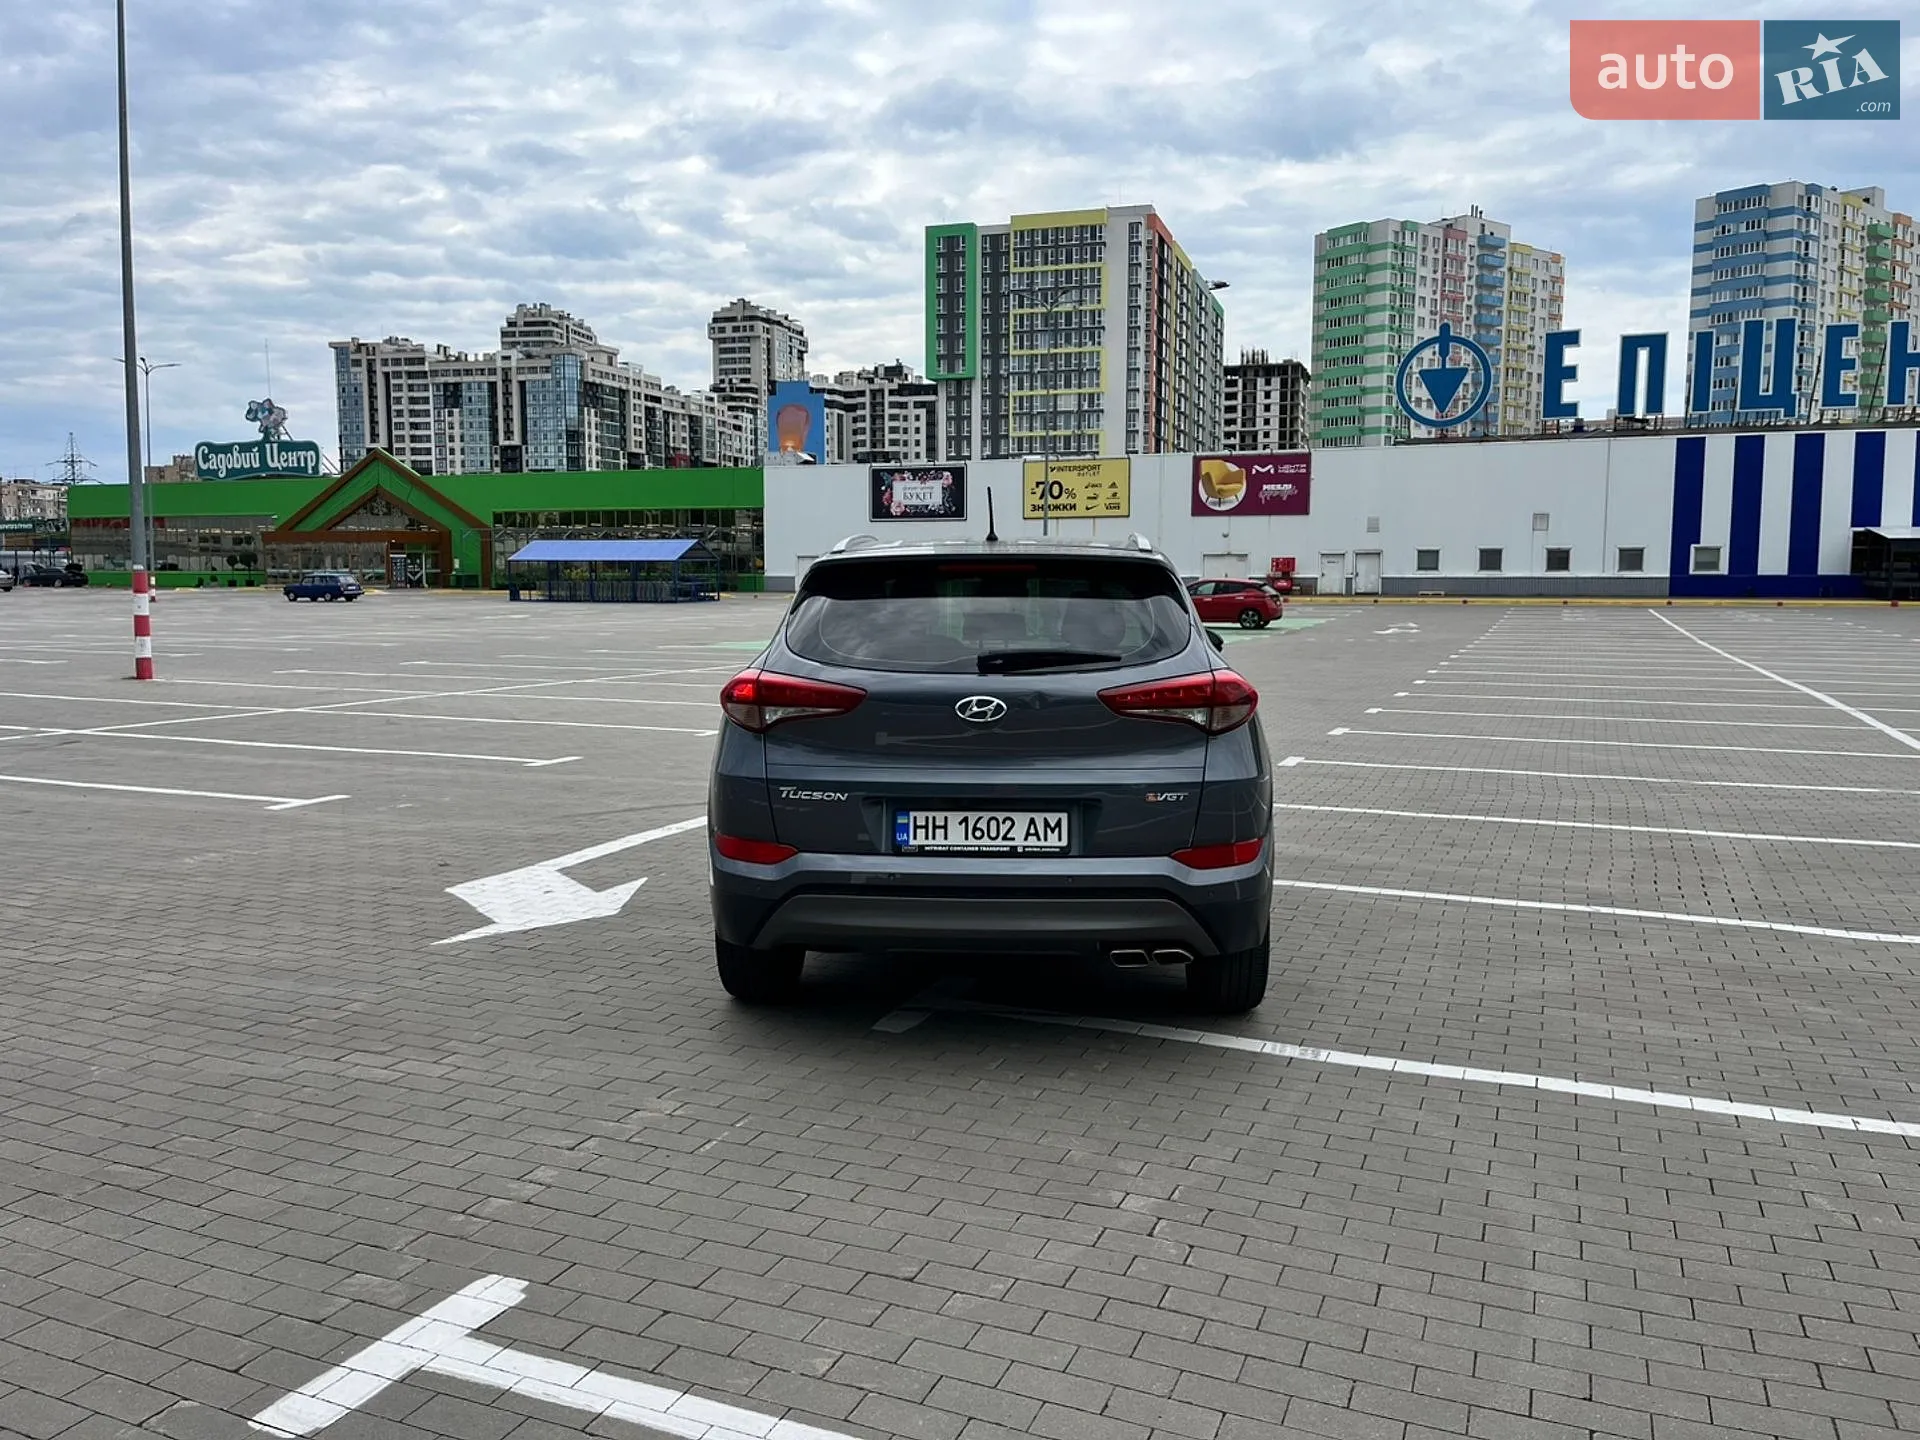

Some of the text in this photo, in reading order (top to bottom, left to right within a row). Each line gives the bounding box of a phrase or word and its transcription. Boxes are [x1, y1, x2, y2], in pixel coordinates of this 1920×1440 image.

[198, 443, 316, 478] Садовий Центр
[1057, 464, 1101, 473] INTERSPORT
[1031, 480, 1077, 500] -70%
[896, 832, 908, 841] UA
[912, 816, 1063, 842] HH 1602 AM
